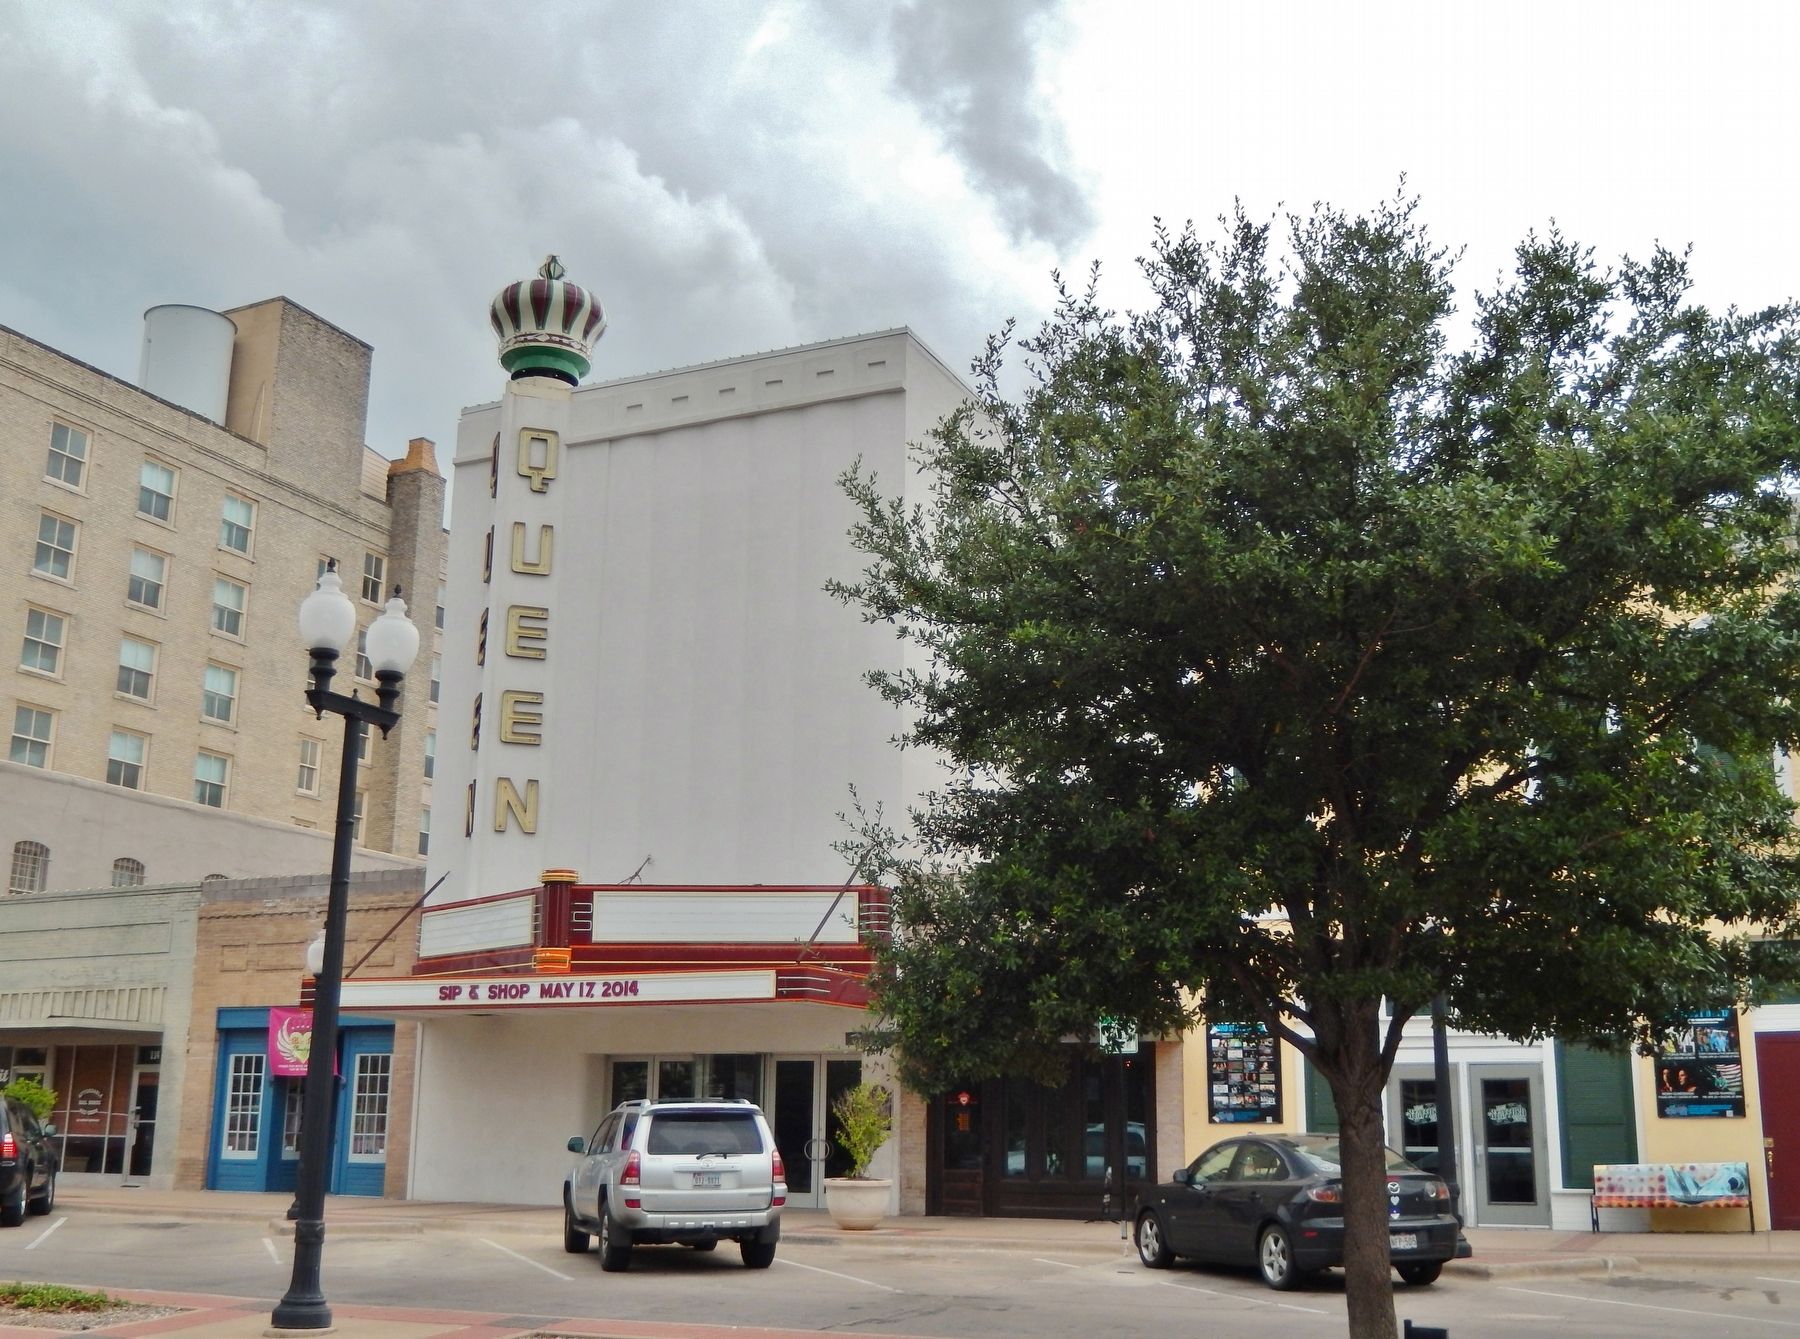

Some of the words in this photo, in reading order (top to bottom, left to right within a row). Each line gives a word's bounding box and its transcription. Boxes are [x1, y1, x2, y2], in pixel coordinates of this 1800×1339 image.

[493, 426, 560, 835] QUEEN
[438, 984, 463, 1001] SIP
[468, 984, 480, 1000] &
[487, 983, 531, 1000] SHOP
[539, 982, 575, 999] MAY
[579, 981, 597, 999] 17,
[601, 980, 640, 998] 2014
